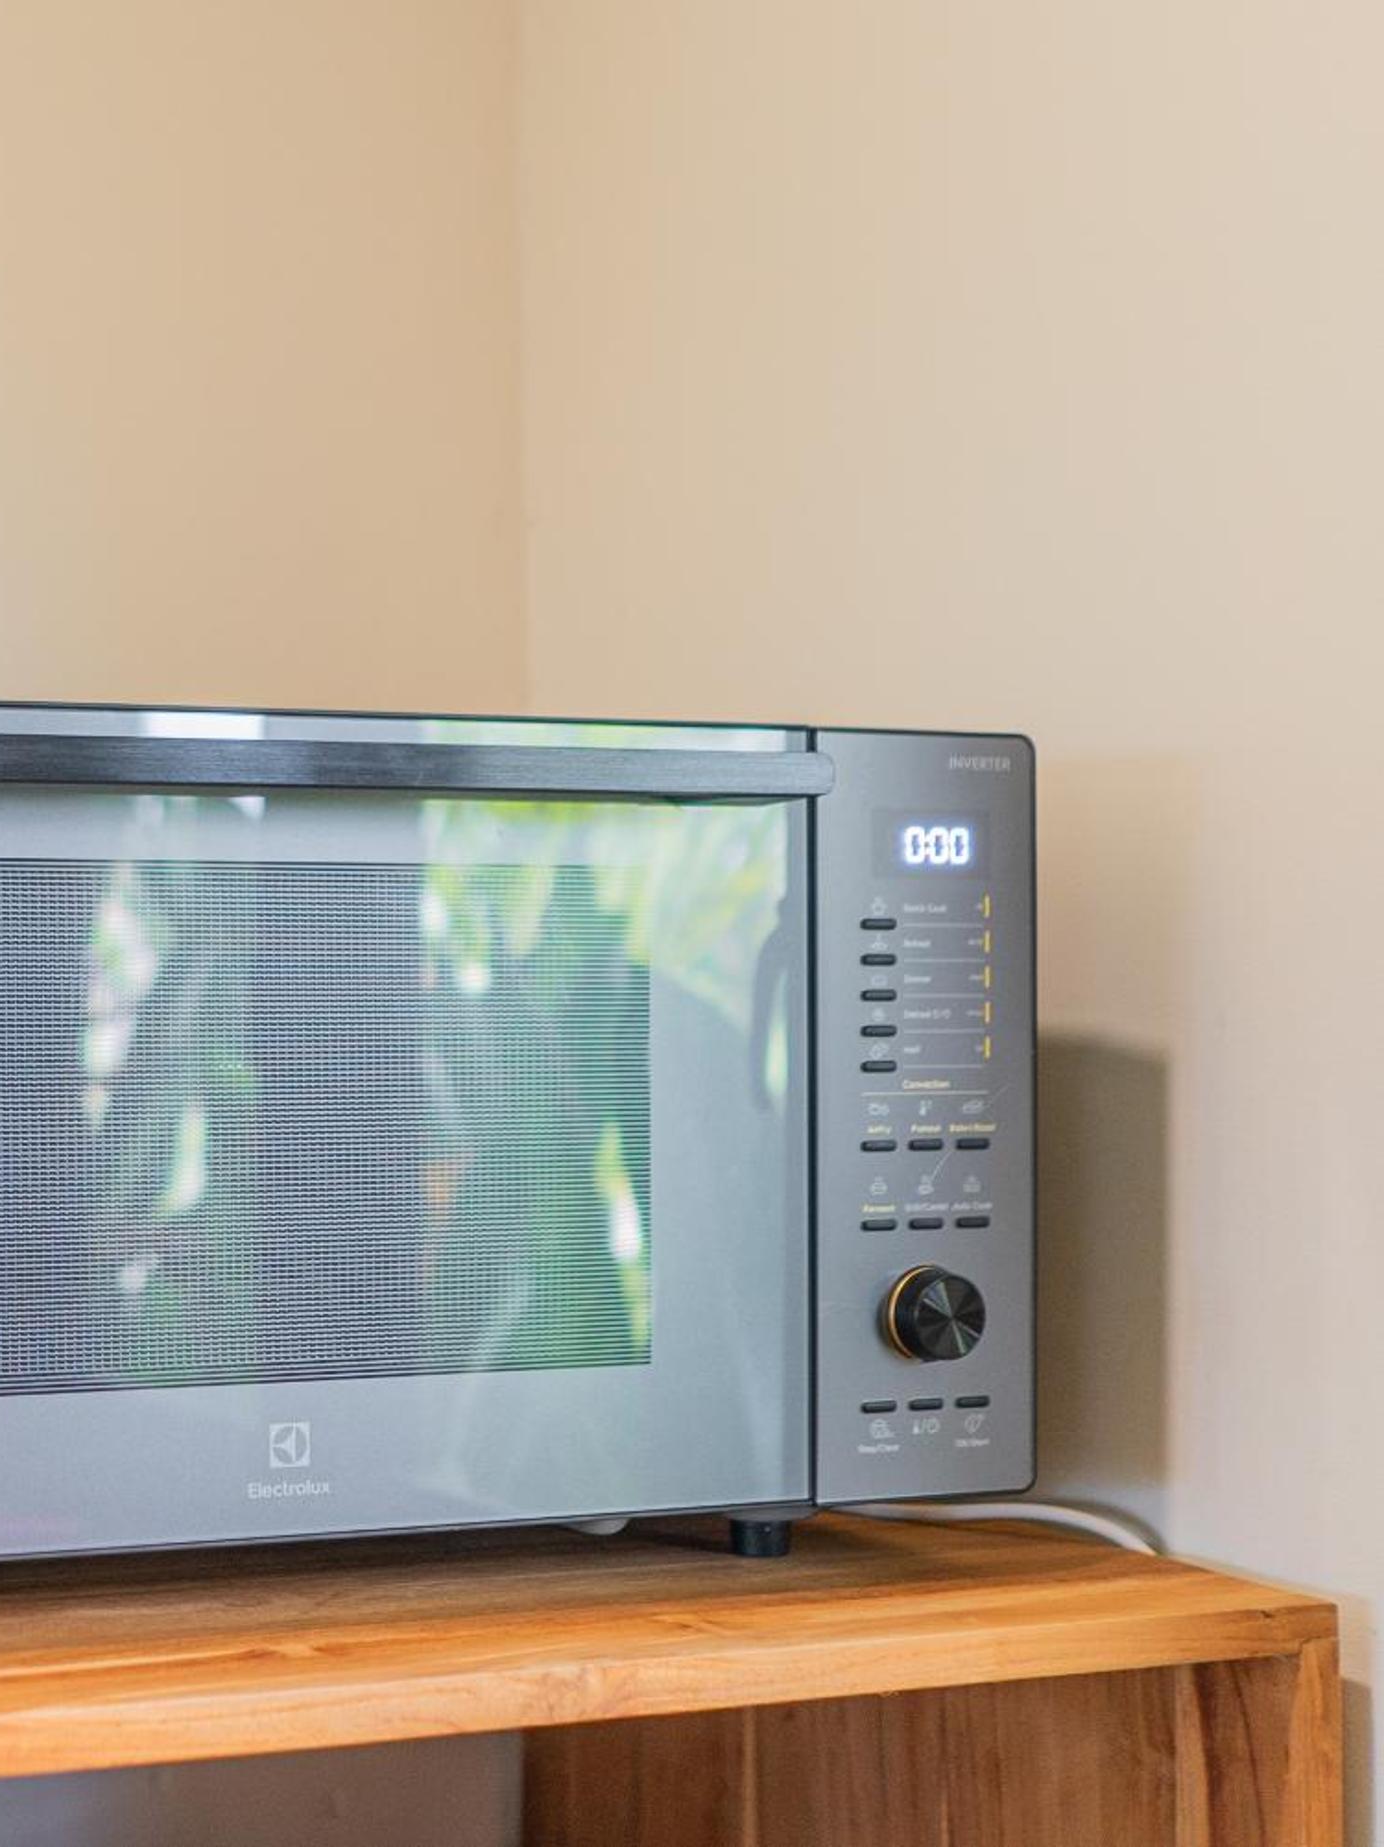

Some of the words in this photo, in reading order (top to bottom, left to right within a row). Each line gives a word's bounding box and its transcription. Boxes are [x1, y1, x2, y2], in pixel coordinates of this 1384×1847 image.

[948, 756, 1011, 771] INVERTER
[903, 825, 970, 865] 0:00
[247, 1479, 330, 1500] Electrolux
